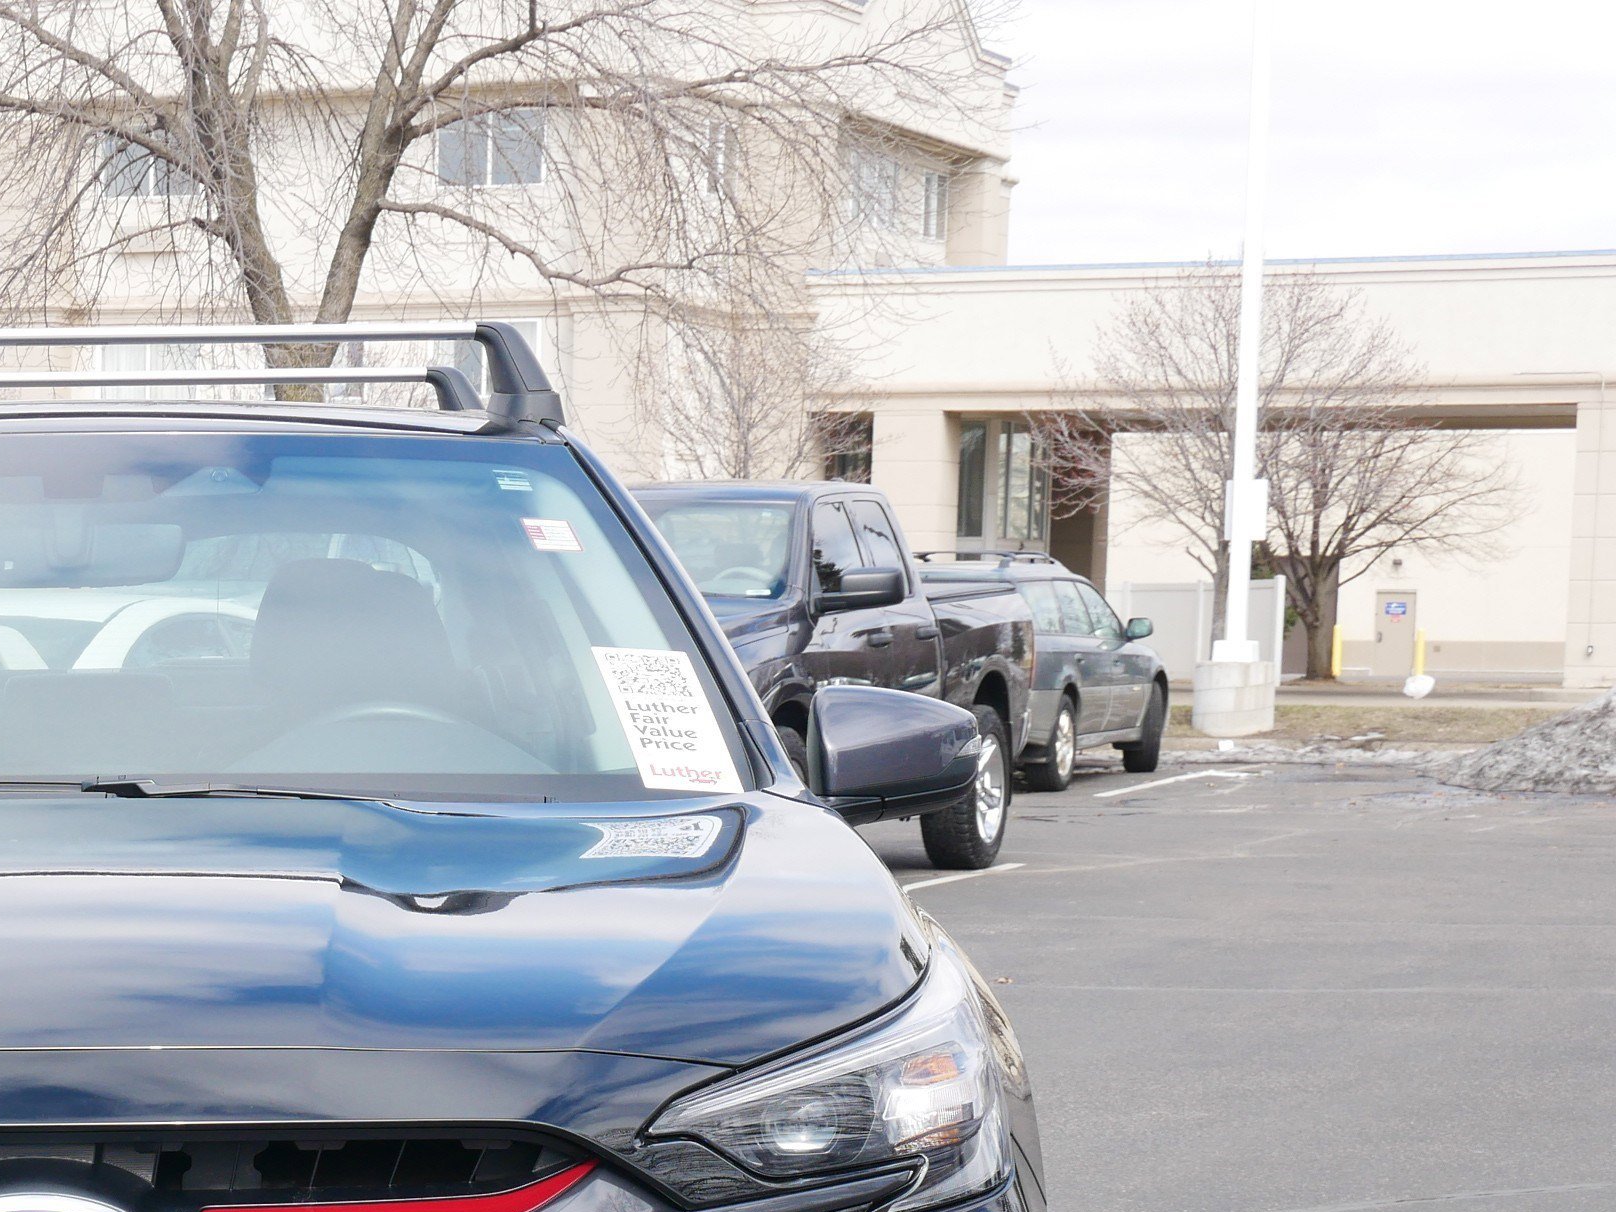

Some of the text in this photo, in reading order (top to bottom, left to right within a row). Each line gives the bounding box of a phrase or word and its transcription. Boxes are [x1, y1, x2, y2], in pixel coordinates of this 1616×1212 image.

[625, 700, 700, 715] Luther
[629, 712, 669, 725] Fair
[633, 724, 698, 739] Value
[640, 737, 697, 752] Price
[649, 764, 722, 780] Luther
